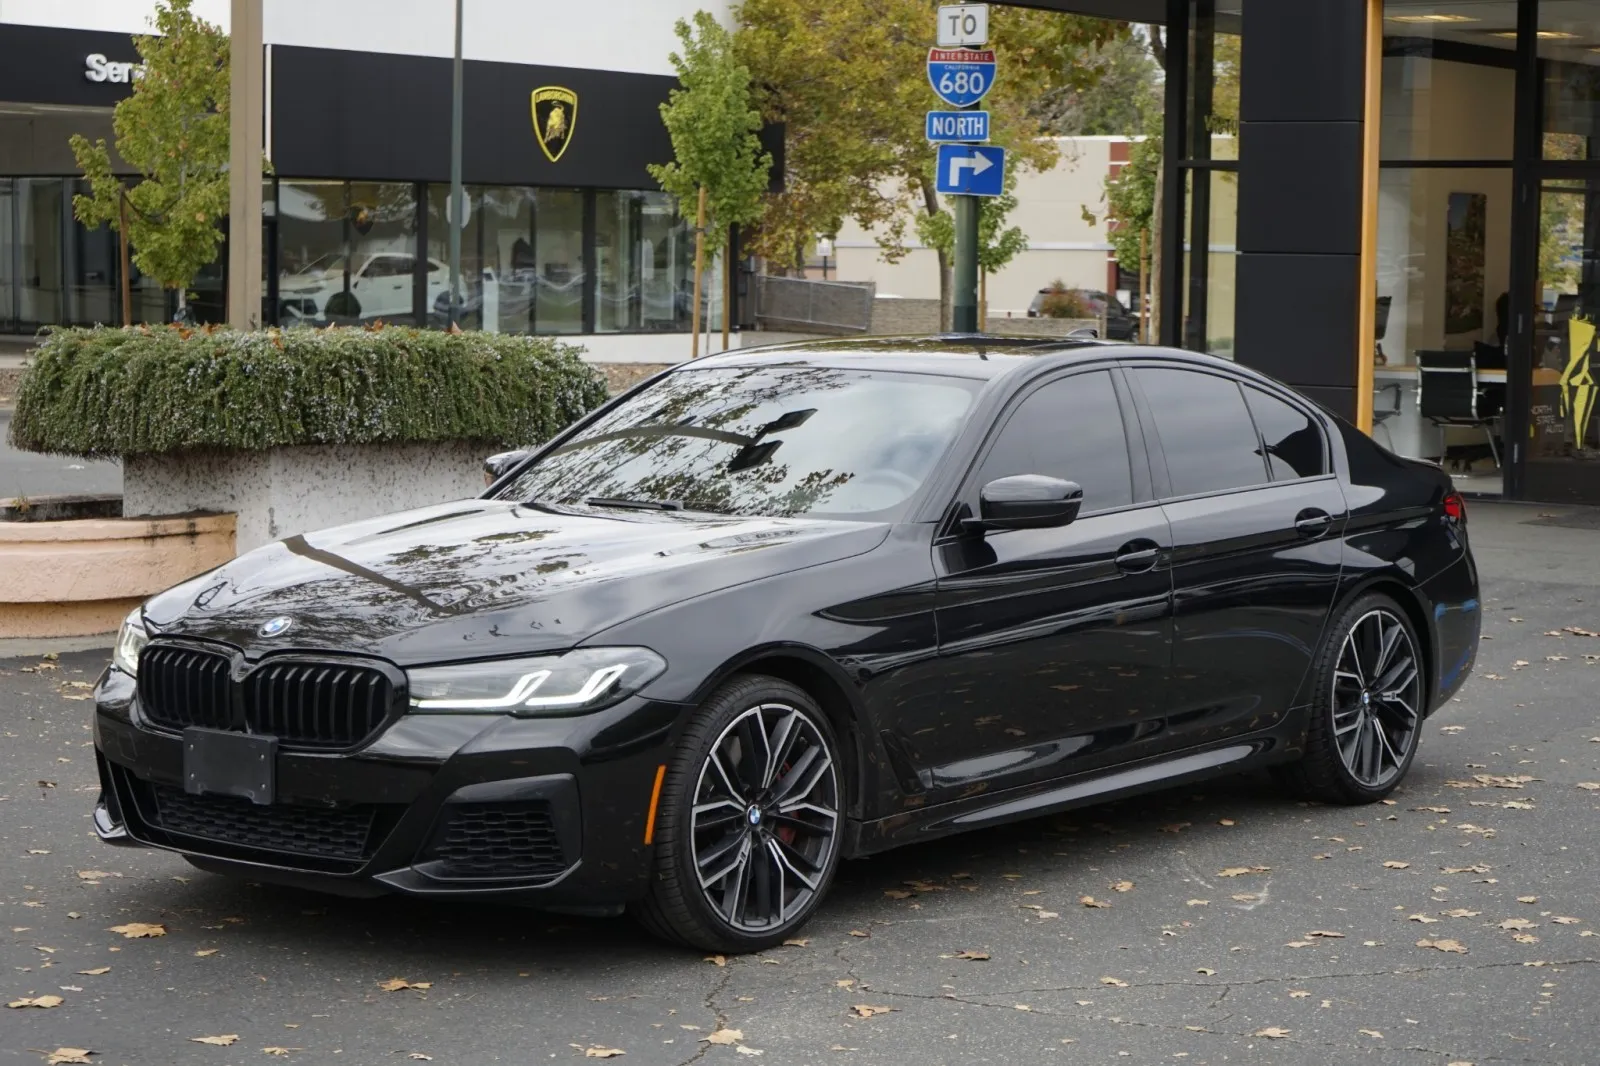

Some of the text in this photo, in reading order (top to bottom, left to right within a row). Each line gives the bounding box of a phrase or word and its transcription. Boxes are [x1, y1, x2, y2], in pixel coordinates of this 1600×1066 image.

[948, 14, 977, 36] TO
[935, 51, 990, 61] INTERSTATE
[939, 72, 984, 94] 680
[932, 117, 984, 136] NORTH
